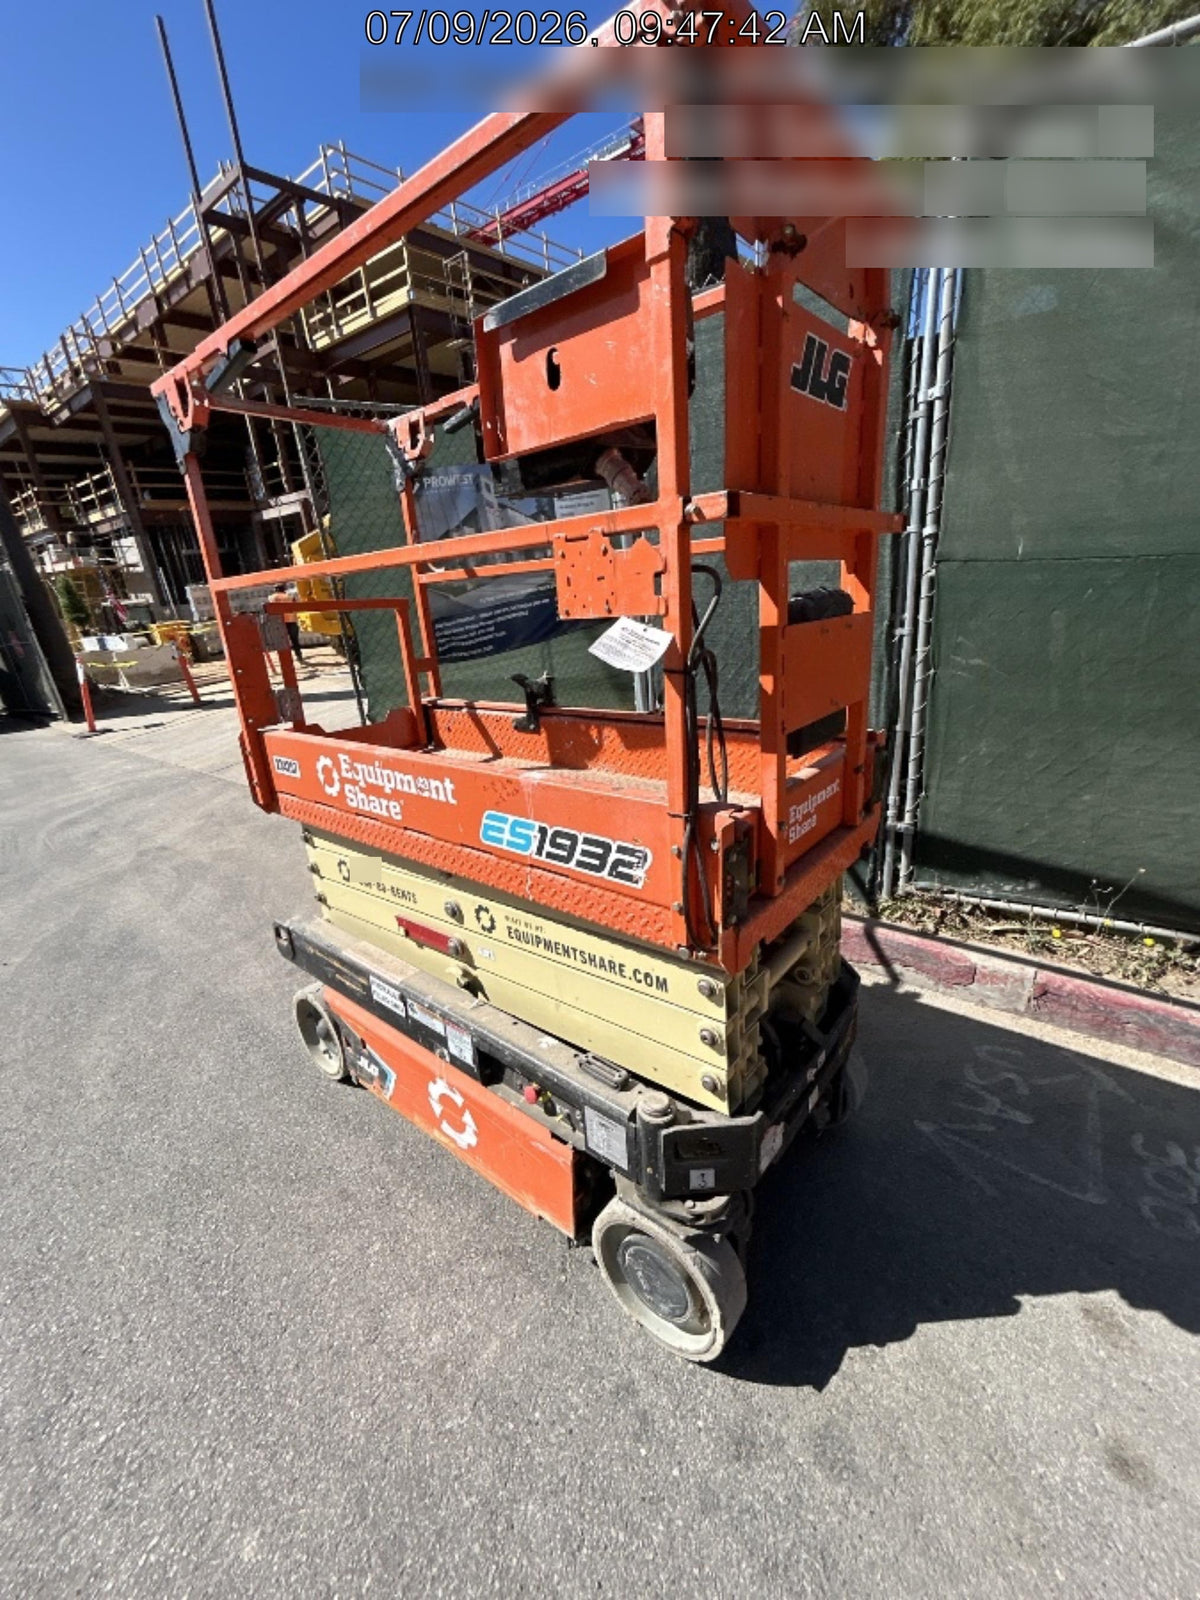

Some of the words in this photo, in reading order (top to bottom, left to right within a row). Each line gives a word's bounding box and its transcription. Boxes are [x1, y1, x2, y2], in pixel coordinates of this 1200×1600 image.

[790, 331, 853, 412] JLG
[338, 753, 457, 804] Equipment
[344, 783, 402, 820] Share
[481, 811, 652, 888] ES1932
[506, 925, 670, 993] EQUIPMENTSHARE.COM
